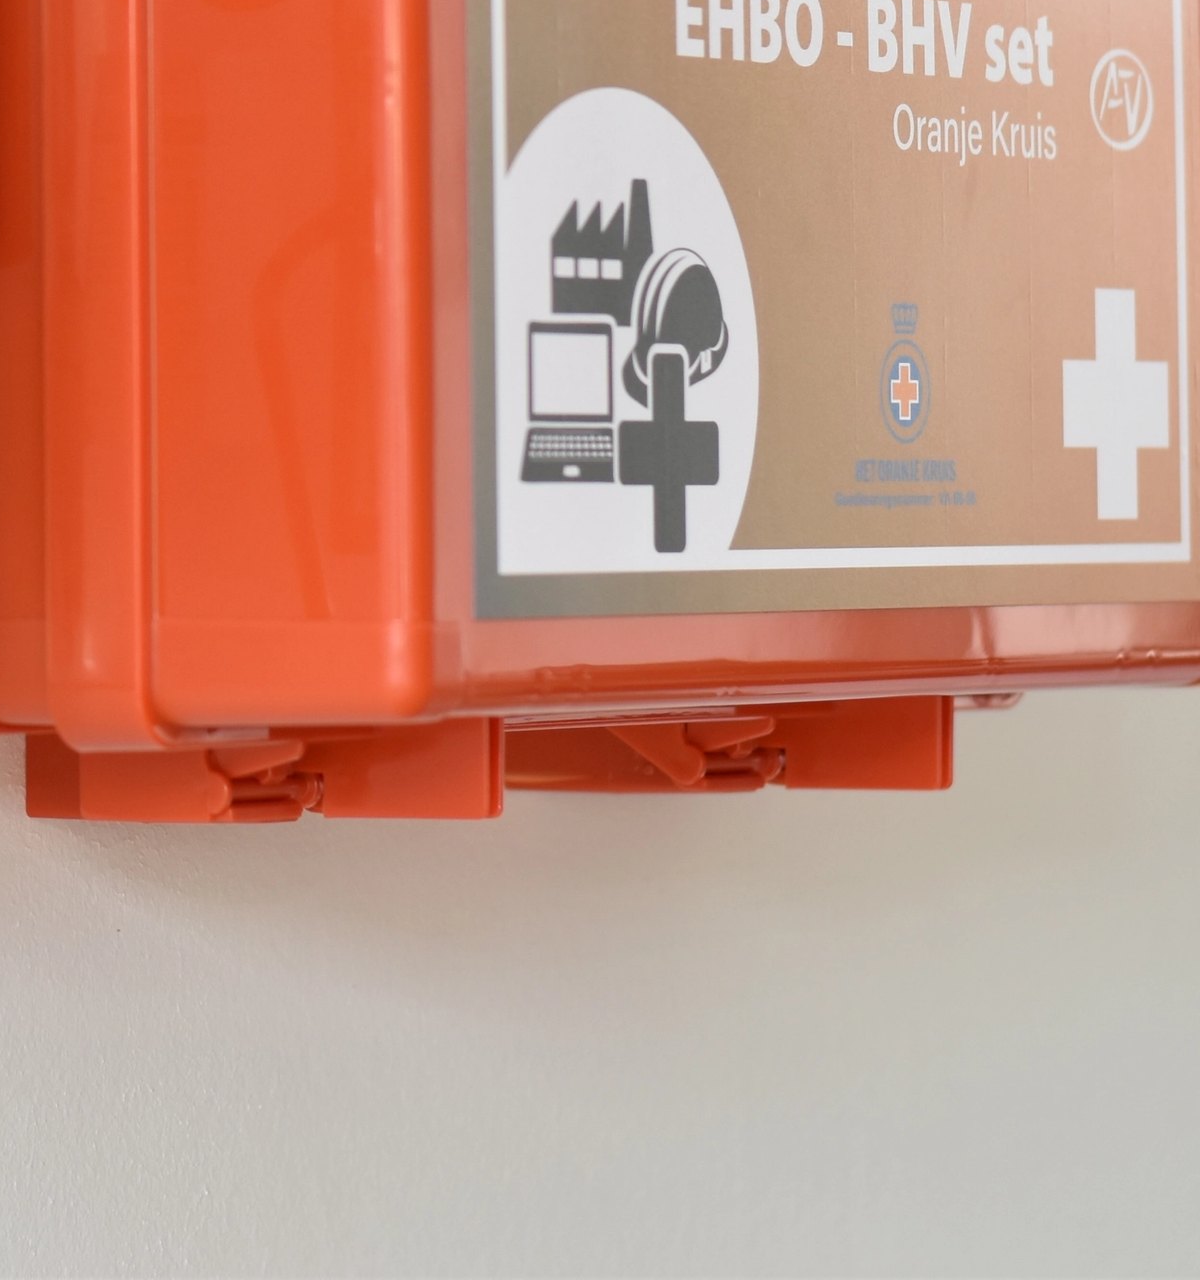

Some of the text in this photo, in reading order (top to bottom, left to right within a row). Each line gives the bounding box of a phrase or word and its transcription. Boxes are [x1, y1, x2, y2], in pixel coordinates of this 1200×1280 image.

[836, 30, 854, 48] -
[984, 15, 1055, 87] set
[892, 103, 1058, 167] Oranje Kruis
